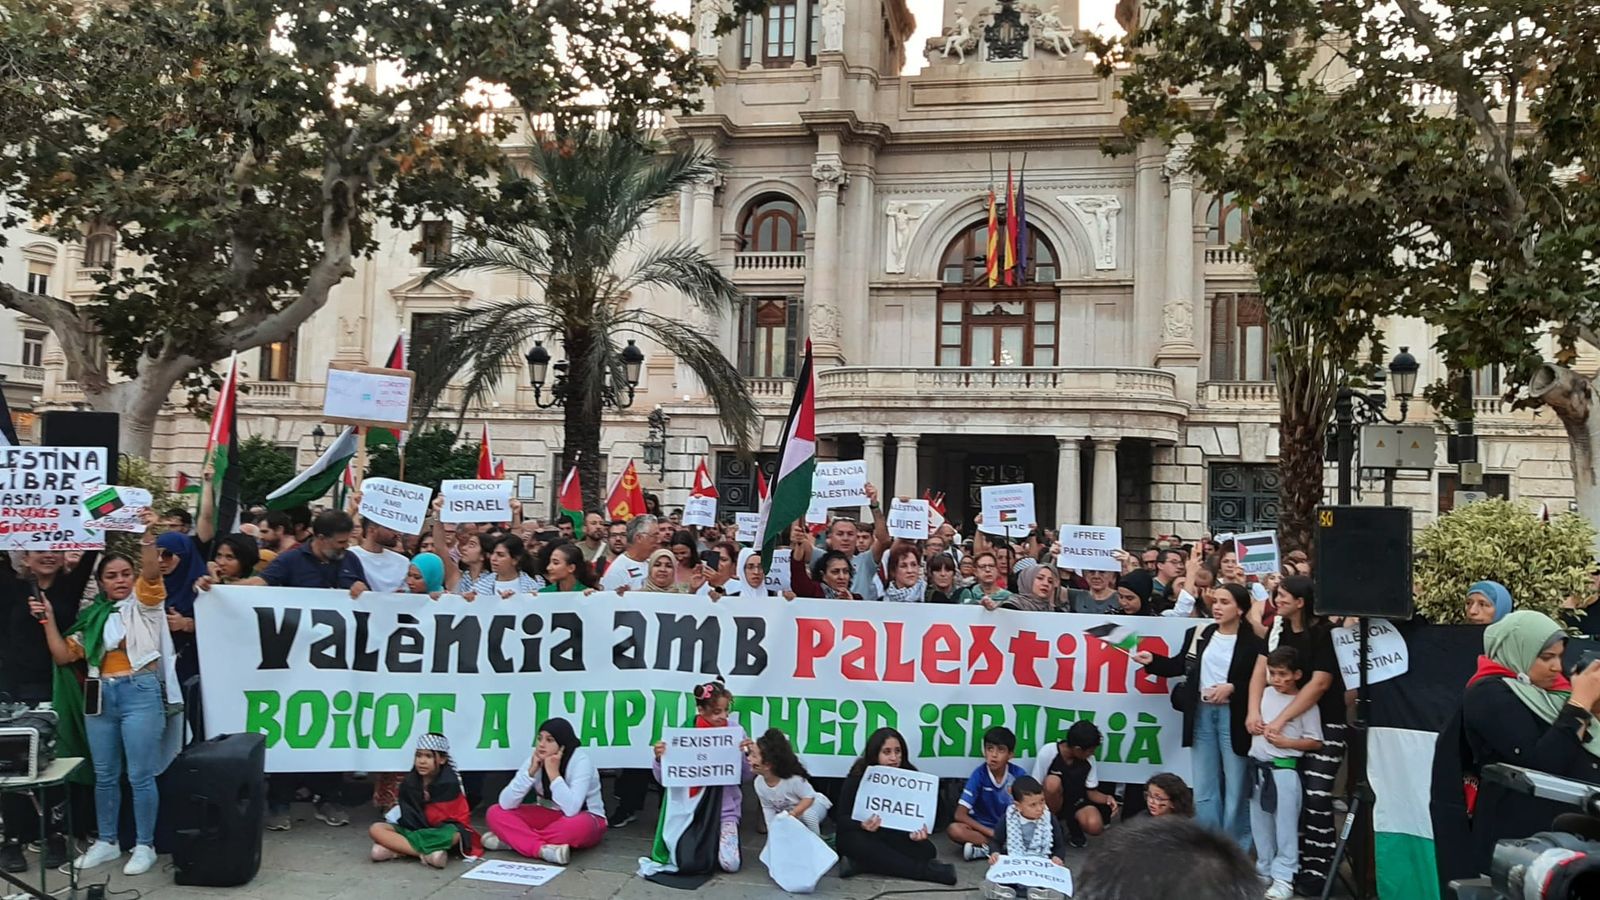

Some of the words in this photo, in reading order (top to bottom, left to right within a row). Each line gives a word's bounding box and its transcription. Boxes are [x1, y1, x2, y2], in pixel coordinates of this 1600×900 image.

[383, 498, 402, 508] AMB
[450, 499, 504, 512] ISRAEL
[362, 502, 418, 525] PALESTINA
[32, 530, 75, 542] STOP
[1073, 531, 1106, 541] #FREE
[477, 692, 511, 749] A
[672, 734, 734, 748] #EXISTIR
[667, 764, 735, 778] RESISTIR
[867, 772, 933, 792] #BOYCOTT
[865, 796, 925, 818] ISRAEL
[498, 863, 546, 872] #STOP
[1003, 858, 1055, 868] #STOP
[993, 869, 1065, 883] APARTHEID
